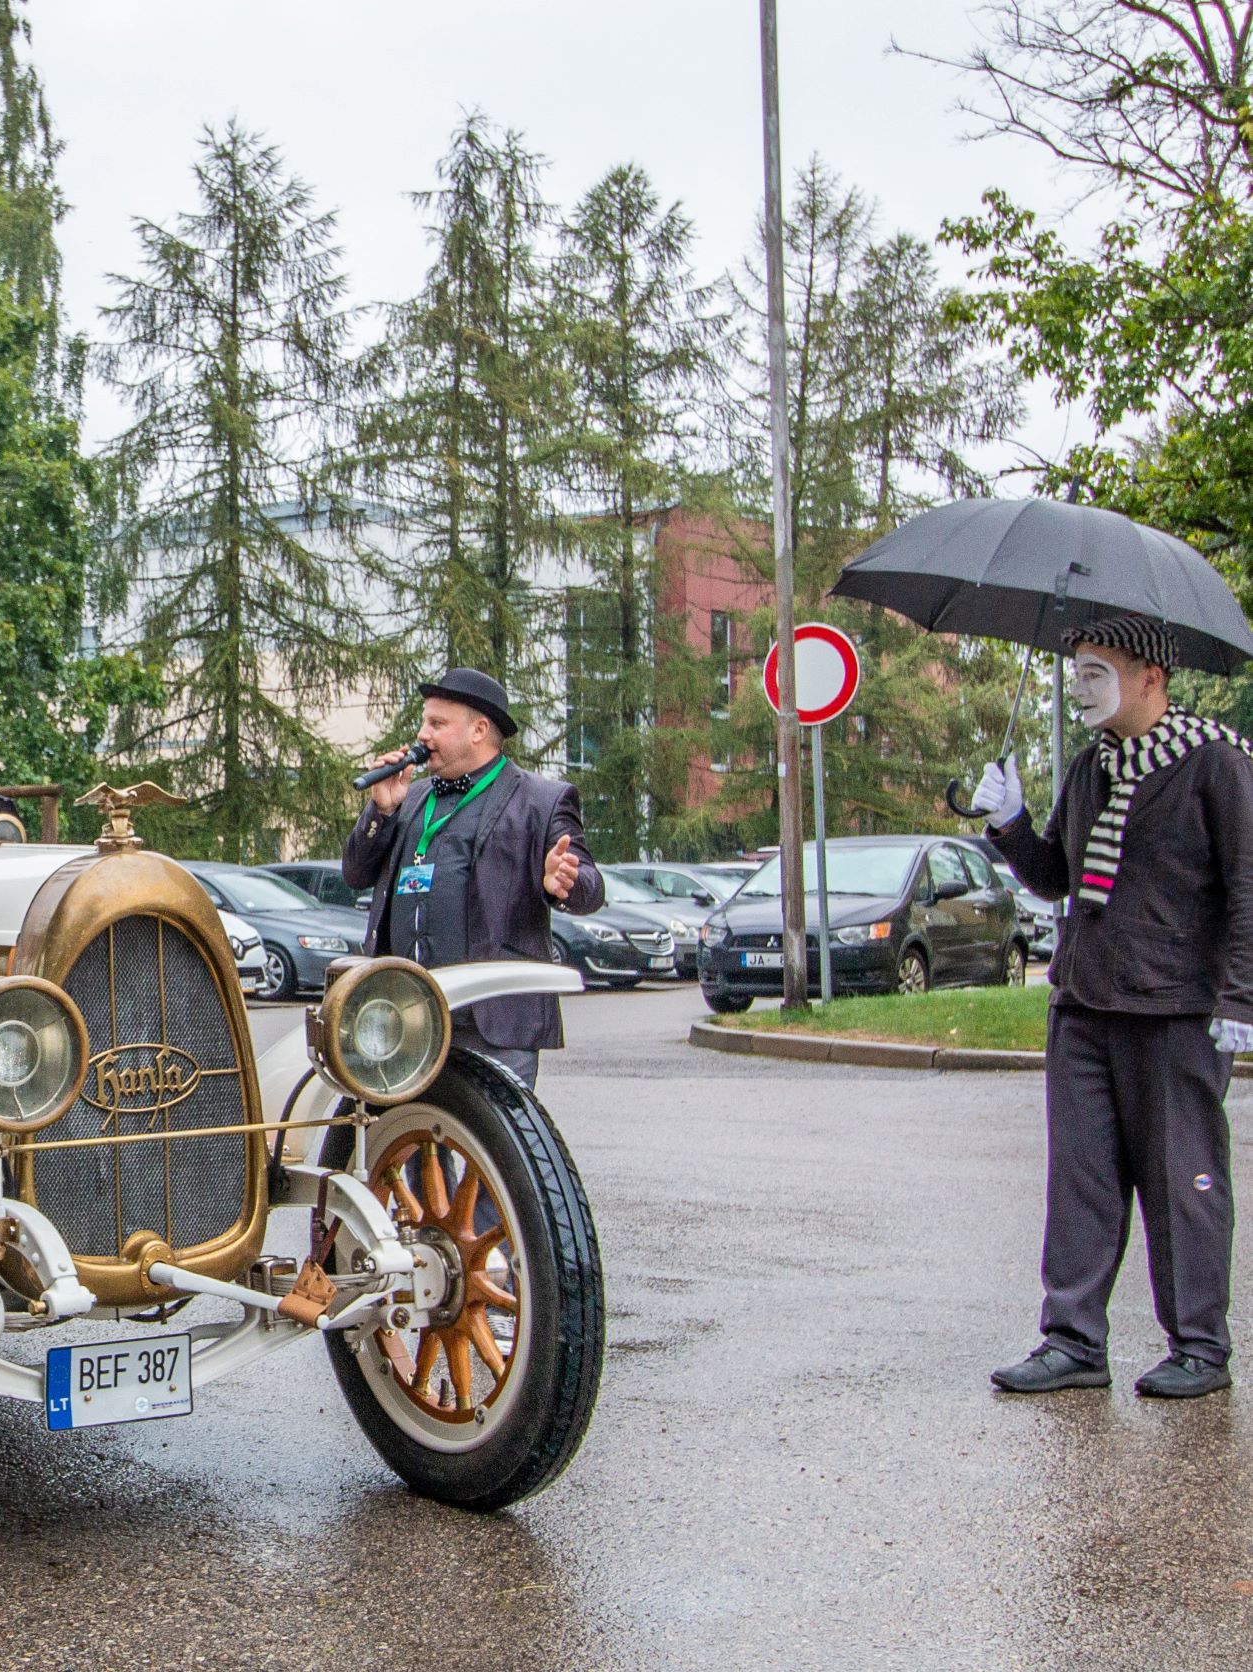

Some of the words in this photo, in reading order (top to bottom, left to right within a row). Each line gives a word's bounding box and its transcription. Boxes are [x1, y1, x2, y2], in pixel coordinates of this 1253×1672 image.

[79, 1352, 130, 1392] BEF
[137, 1346, 180, 1384] 387
[50, 1397, 69, 1413] LT
